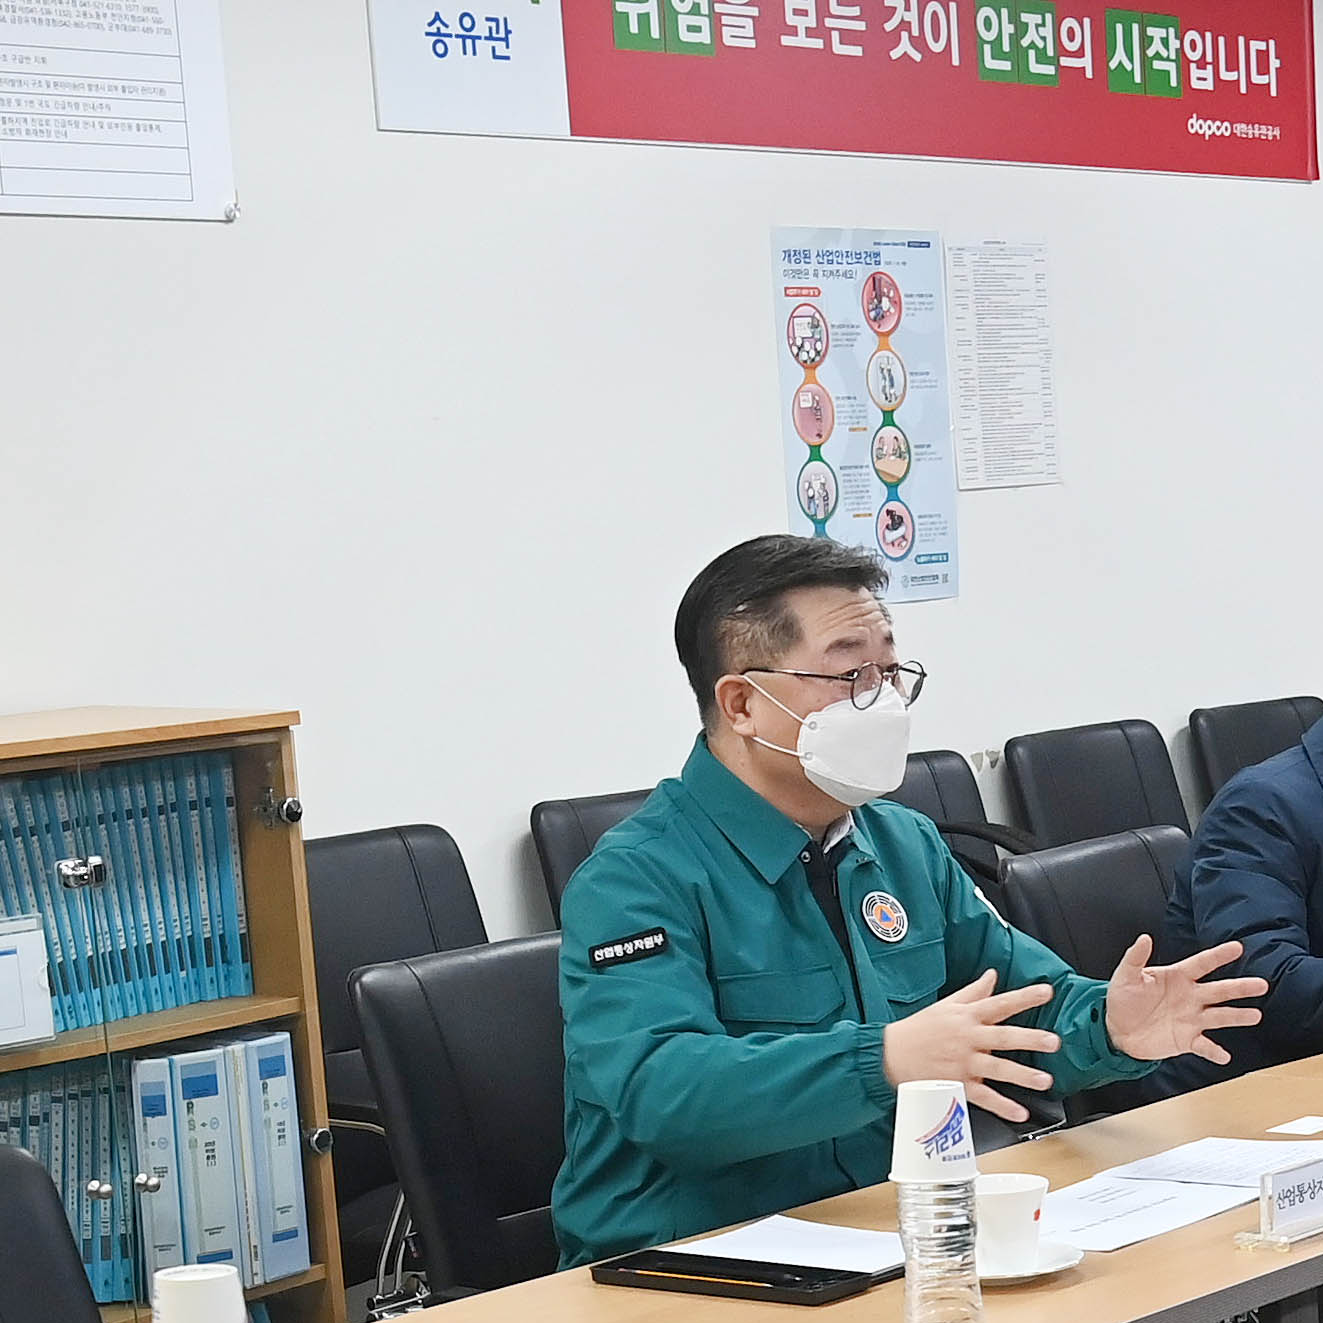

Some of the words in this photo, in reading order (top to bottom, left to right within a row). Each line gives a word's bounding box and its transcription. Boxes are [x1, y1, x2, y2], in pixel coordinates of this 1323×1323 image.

[424, 10, 513, 61] 송유관
[779, 0, 867, 57] 모든
[882, 0, 961, 67] 것이
[975, 6, 1094, 80] 안전의
[1108, 22, 1281, 97] 시작입니다
[1187, 112, 1232, 141] dopco
[1232, 122, 1281, 141] 대한송유관공사
[782, 248, 812, 265] 개정된
[815, 249, 882, 266] 산업안전보건법
[594, 933, 664, 961] 산업통상자원부
